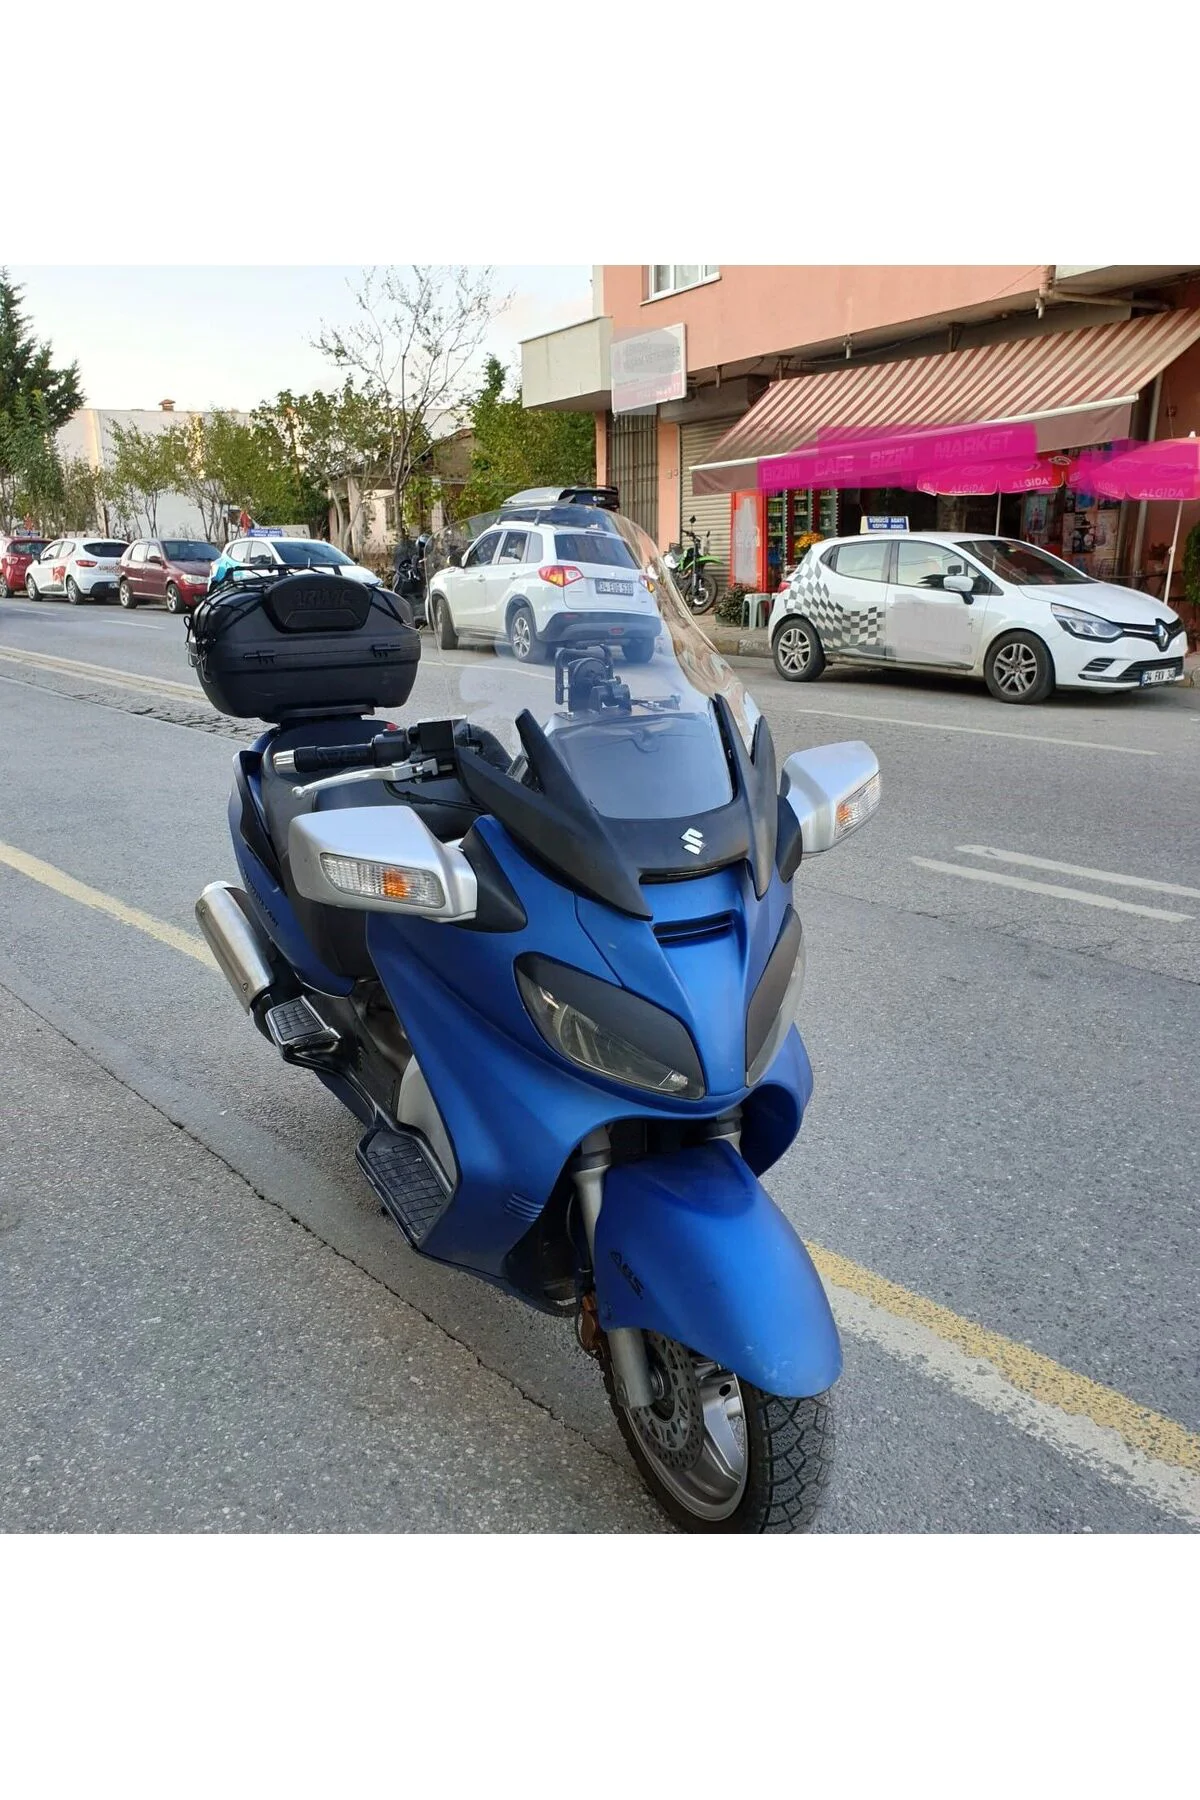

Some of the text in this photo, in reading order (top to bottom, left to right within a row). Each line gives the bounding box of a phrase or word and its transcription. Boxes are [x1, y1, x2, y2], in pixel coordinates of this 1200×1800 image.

[814, 455, 855, 476] CAFE
[934, 430, 1013, 459] MARKET
[1012, 477, 1051, 490] ALGIDA
[1139, 488, 1186, 498] ALGIDA
[608, 1250, 646, 1300] ABS
